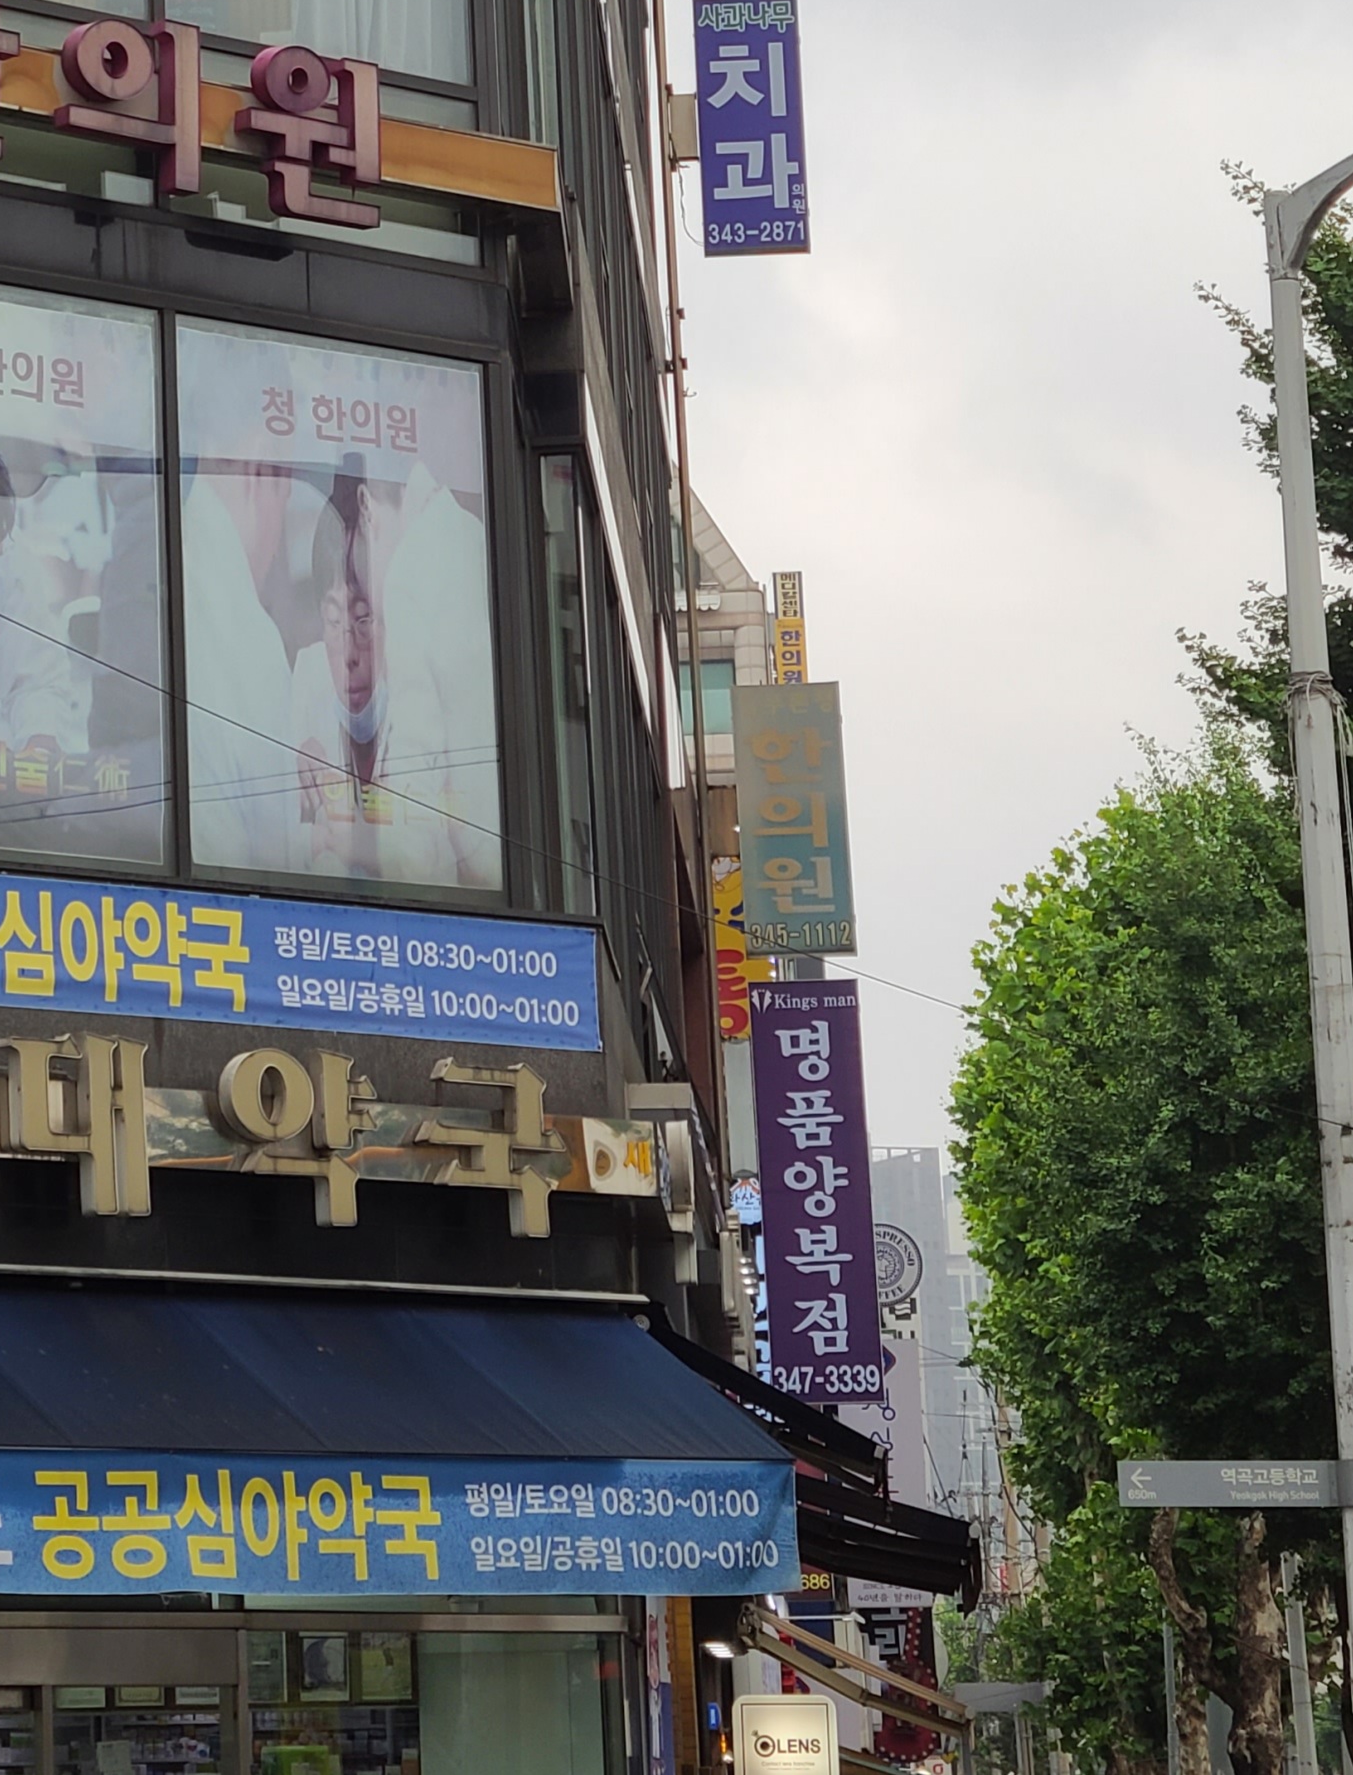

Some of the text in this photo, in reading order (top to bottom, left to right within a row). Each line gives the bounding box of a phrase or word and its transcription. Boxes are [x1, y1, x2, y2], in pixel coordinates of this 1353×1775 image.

[698, 1, 795, 32] 사과나무
[707, 42, 799, 208] 치과
[791, 183, 805, 214] 의원
[708, 221, 805, 245] 343-2871
[261, 386, 420, 454] 청 한의원
[744, 726, 836, 915] 한의원
[274, 924, 557, 979] 평일/토요일 08:30~01:00
[750, 920, 852, 949] 345-1112
[277, 974, 579, 1027] 일요일/공휴일 10:00~01:00
[775, 993, 856, 1011] Kings man
[774, 1020, 854, 1356] 명품양복점
[874, 1230, 915, 1267] SPRESSO
[772, 1363, 880, 1394] 347-3339
[1221, 1467, 1319, 1486] 역곡고등학교
[464, 1482, 759, 1518] 평일/토요일 08:30~01:00
[1128, 1489, 1319, 1503] 650m Yeokgok High School
[32, 1469, 442, 1582] 공공심야약국
[470, 1535, 780, 1573] 일요일/공휴일 10:00~01:00
